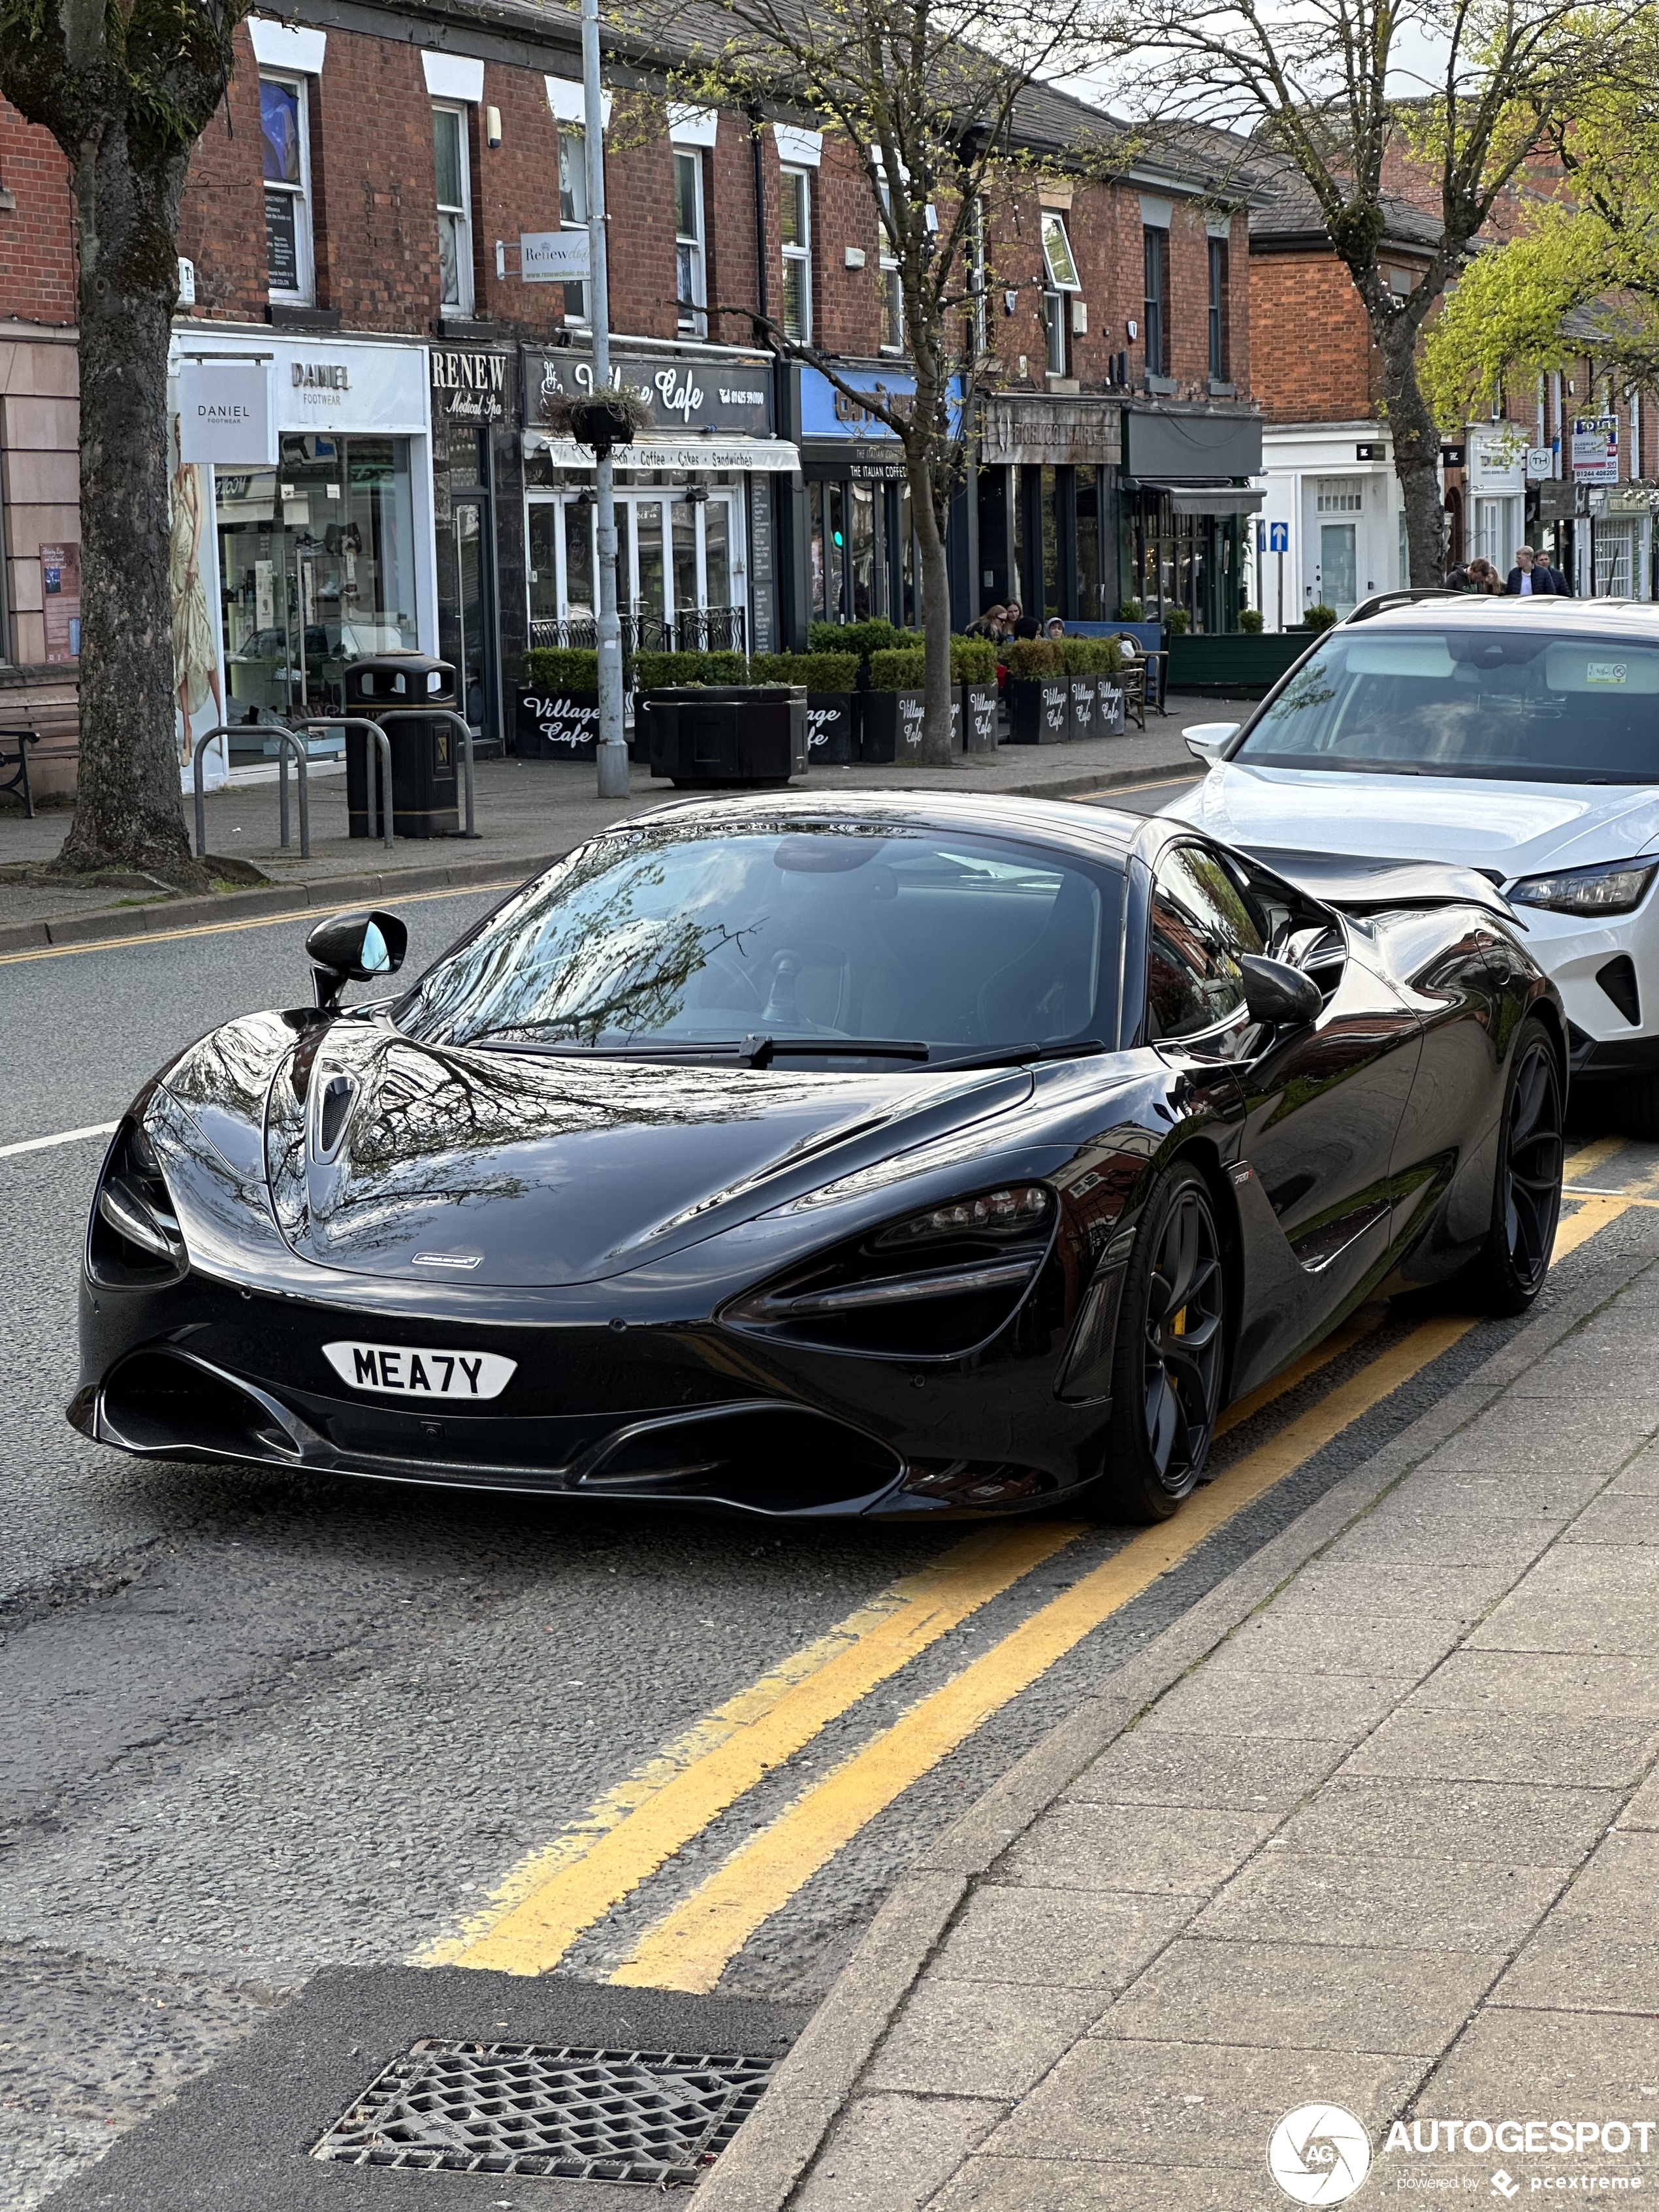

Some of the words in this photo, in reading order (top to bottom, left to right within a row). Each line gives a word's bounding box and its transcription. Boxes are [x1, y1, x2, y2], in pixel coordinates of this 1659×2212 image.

[526, 248, 567, 261] Renew
[526, 270, 590, 279] www.renewclinic.co.u
[291, 362, 350, 390] DANIEL
[432, 352, 506, 391] RENEW
[303, 394, 341, 406] FOOTWEAR
[444, 391, 484, 415] Medical
[484, 394, 502, 423] Spa
[655, 368, 704, 423] Cafe
[198, 406, 250, 417] DANIEL
[641, 451, 666, 466] Coffee
[679, 451, 700, 467] Cakes
[713, 452, 753, 468] Sandwiches
[850, 465, 861, 477] THE
[863, 466, 884, 478] ITALIAN
[1043, 686, 1067, 709] Village
[1072, 682, 1095, 705] Village
[1099, 681, 1123, 704] Village
[523, 697, 600, 725] Village
[971, 693, 996, 716] Village
[1076, 704, 1091, 727] Cafe
[1102, 702, 1119, 724] Cafe
[975, 715, 993, 740] Cafe
[1047, 709, 1064, 731] Cafe
[540, 721, 593, 748] Cafe
[807, 726, 828, 751] fe
[904, 722, 922, 748] Cafe
[353, 1348, 482, 1394] MEA7Y
